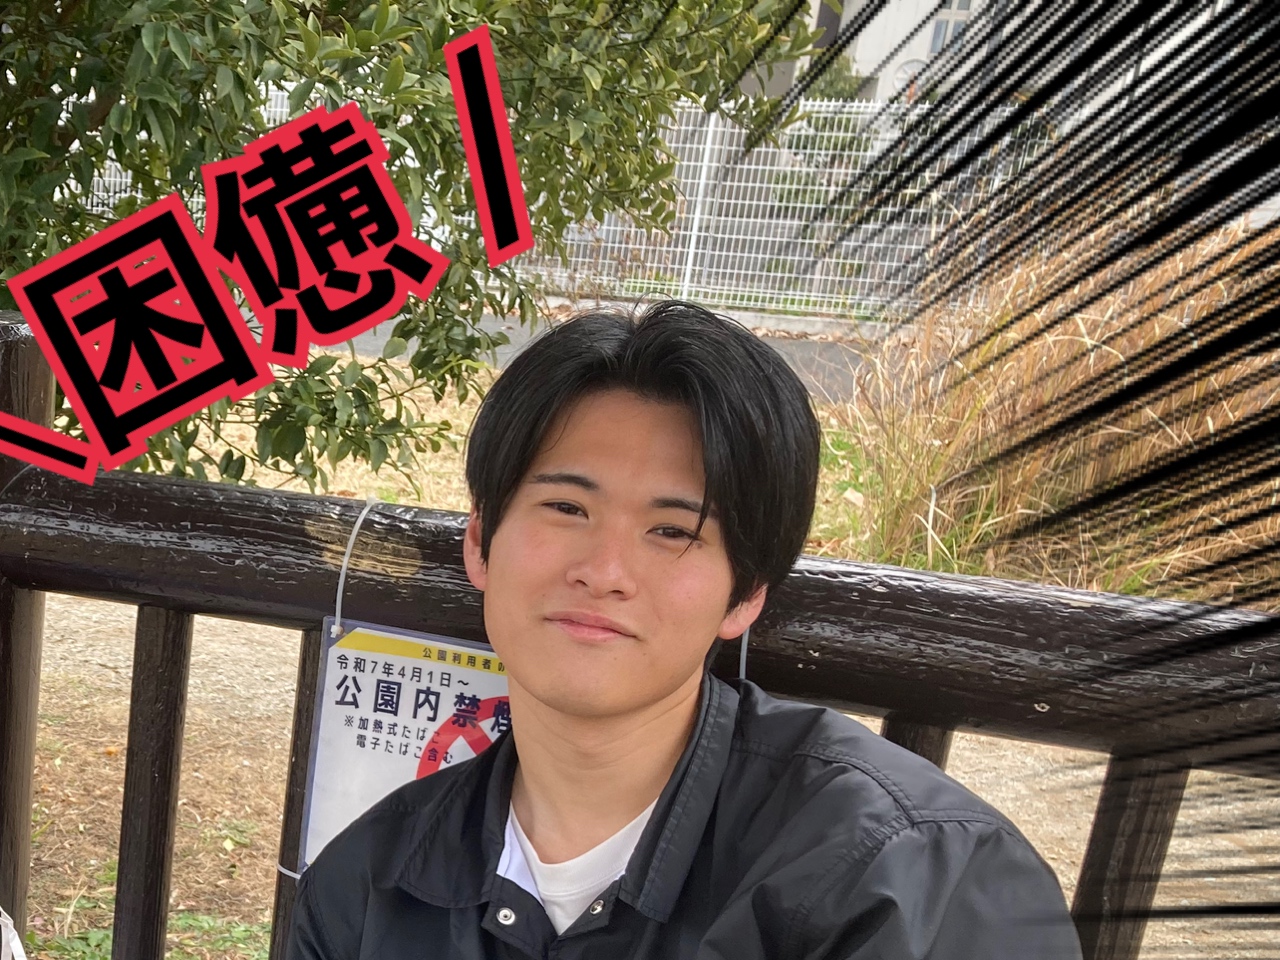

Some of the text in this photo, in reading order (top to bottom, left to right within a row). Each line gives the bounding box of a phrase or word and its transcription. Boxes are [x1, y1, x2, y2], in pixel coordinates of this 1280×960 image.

[356, 733, 454, 764] 電子たばこ含む
